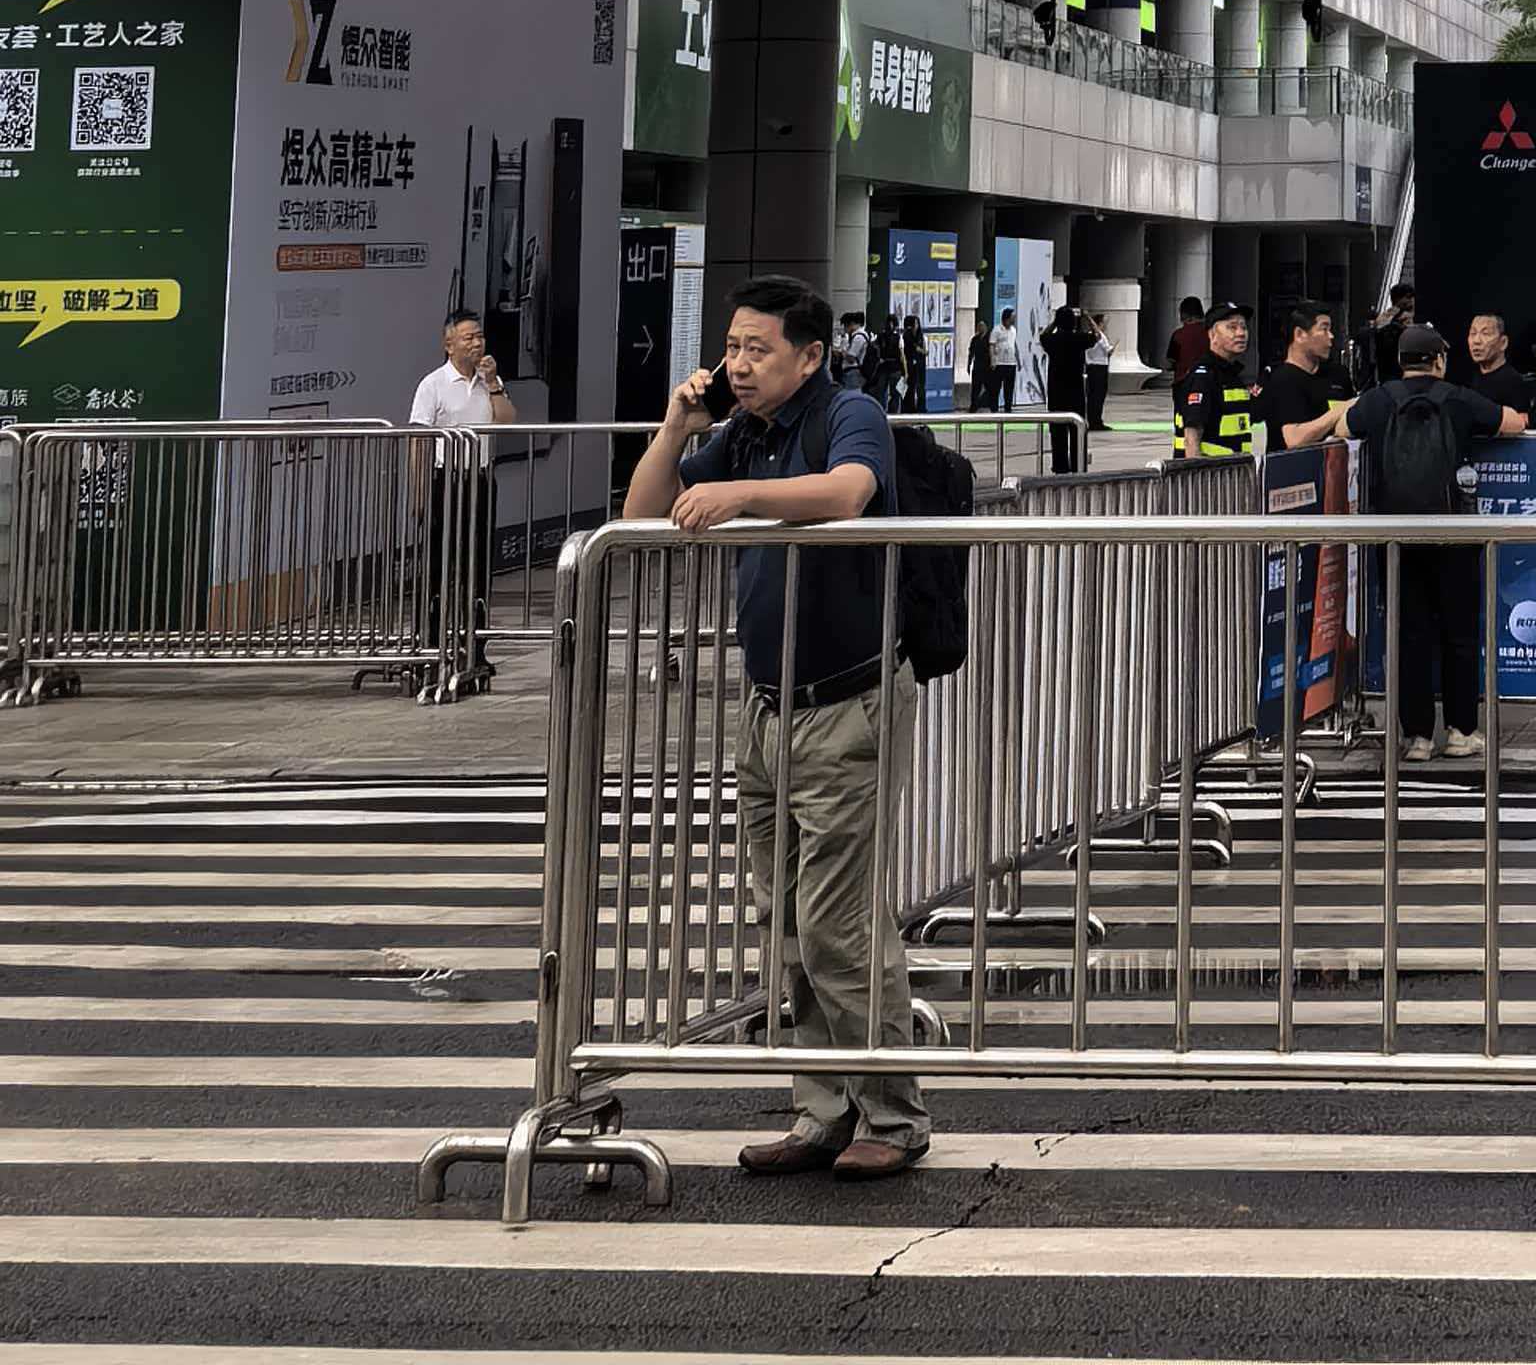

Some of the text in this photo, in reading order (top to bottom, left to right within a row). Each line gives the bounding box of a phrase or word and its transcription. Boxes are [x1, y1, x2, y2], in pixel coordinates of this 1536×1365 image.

[870, 39, 933, 114] 具身智能
[627, 242, 667, 282] 出口
